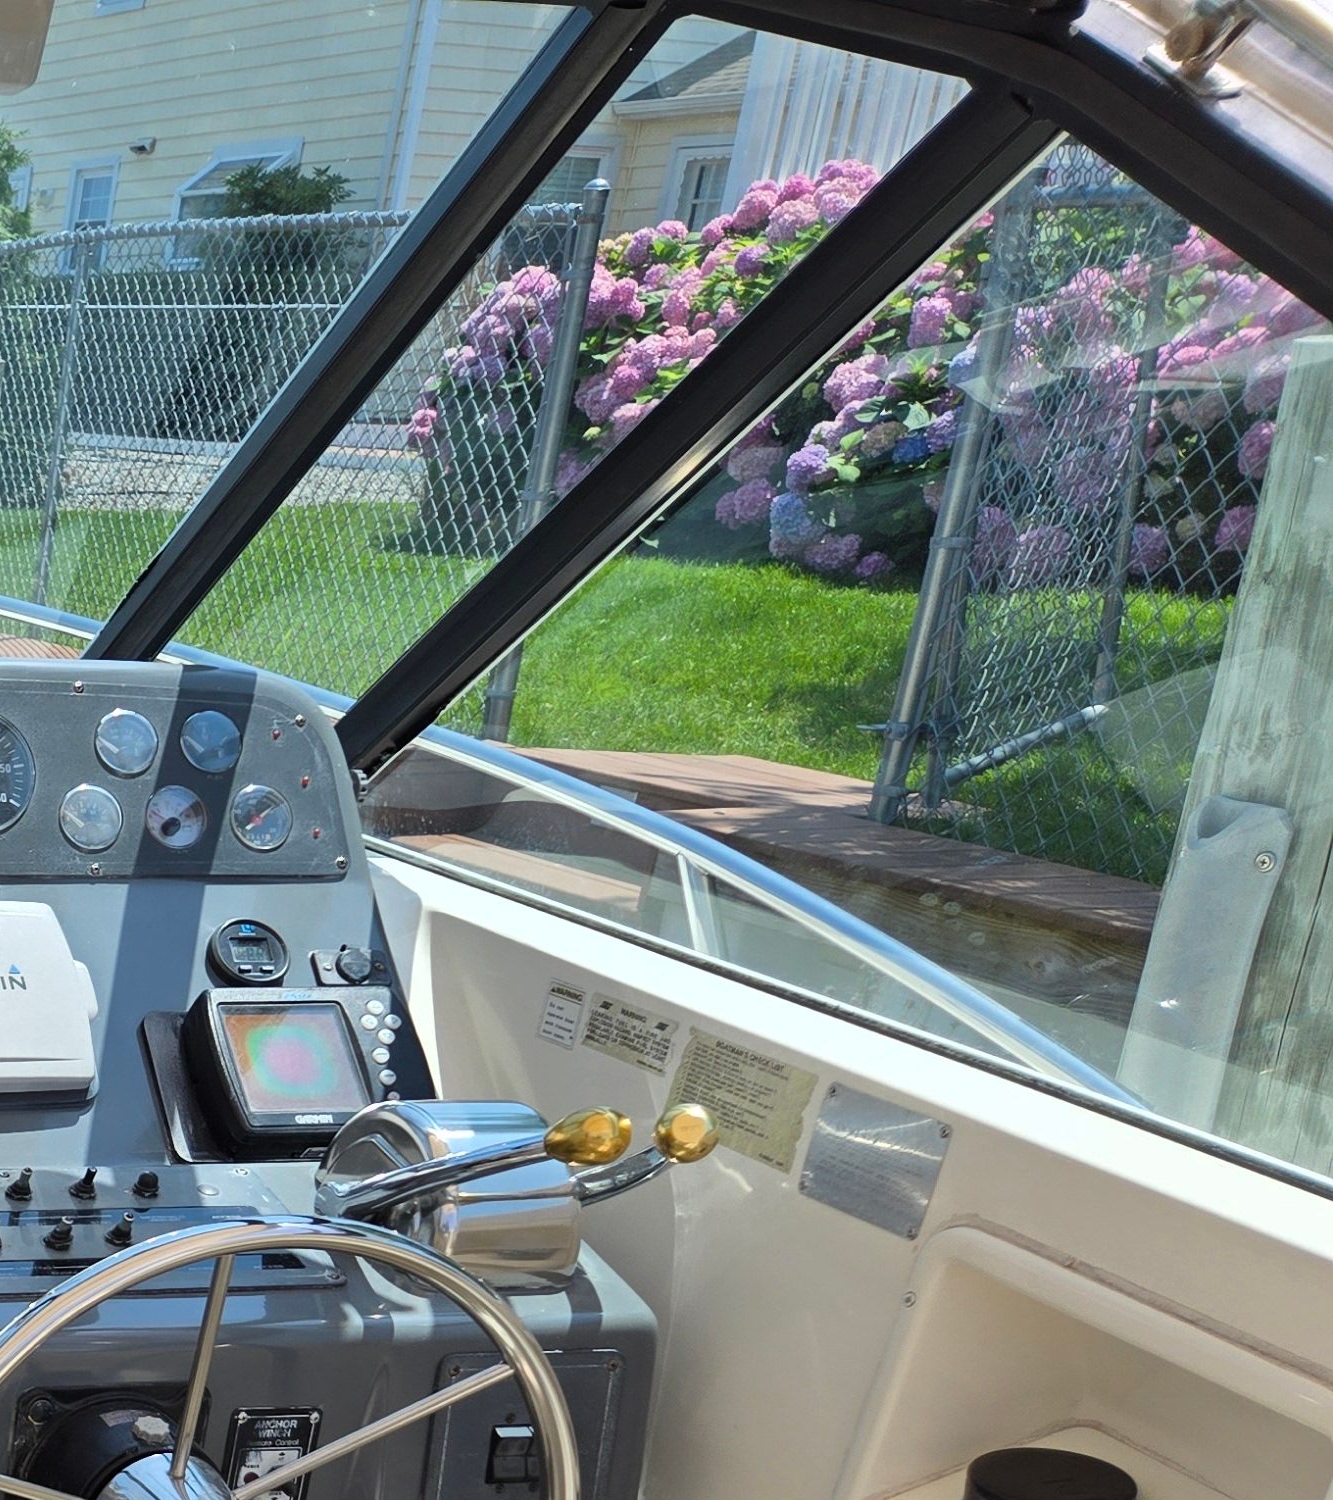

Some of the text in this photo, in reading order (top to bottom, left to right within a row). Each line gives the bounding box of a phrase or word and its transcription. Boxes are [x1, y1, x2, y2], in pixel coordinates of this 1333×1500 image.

[0, 764, 11, 773] 50
[556, 988, 582, 1001] WARNING
[621, 1008, 647, 1023] WARNING
[295, 1114, 333, 1124] GARMIN
[255, 1419, 298, 1429] ANCHOR
[258, 1429, 292, 1438] WINCH
